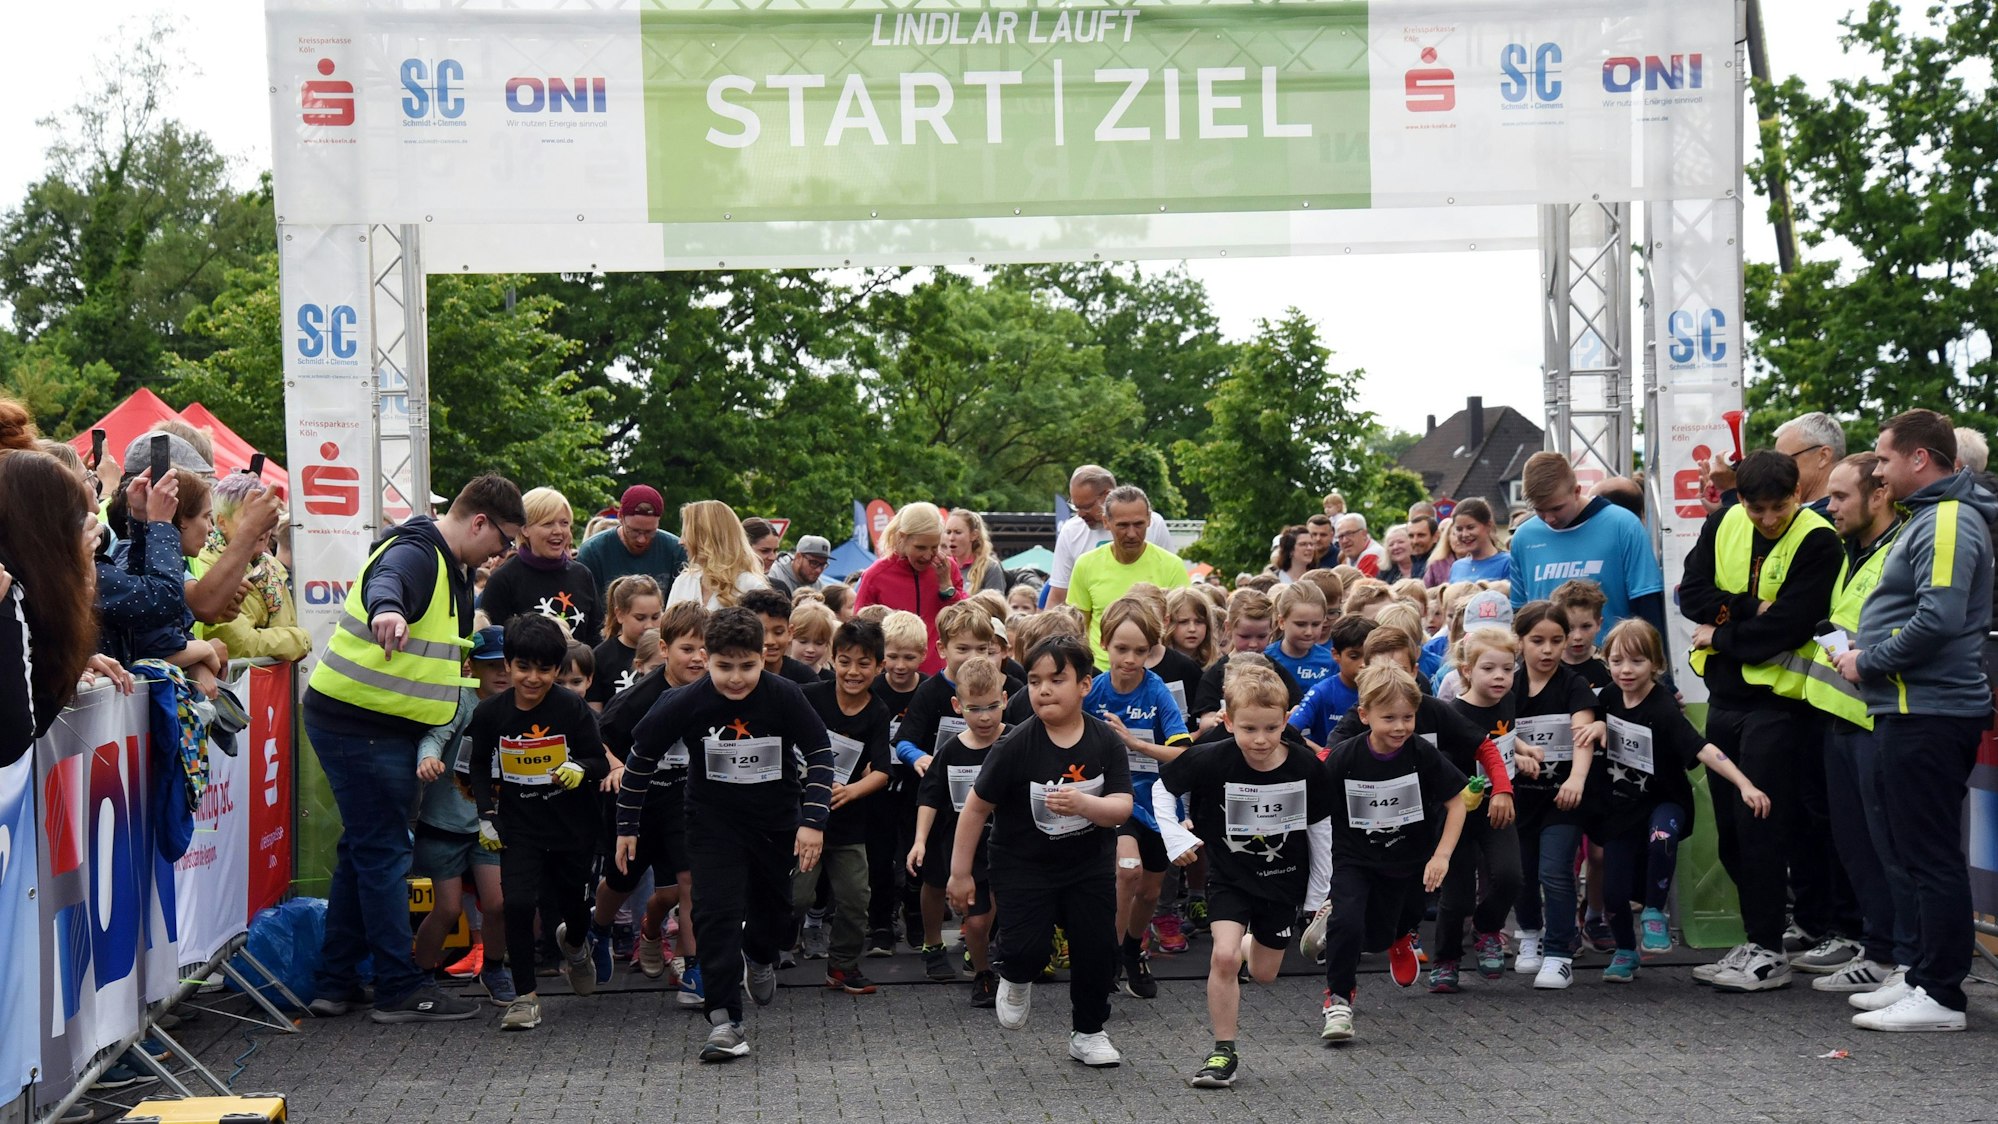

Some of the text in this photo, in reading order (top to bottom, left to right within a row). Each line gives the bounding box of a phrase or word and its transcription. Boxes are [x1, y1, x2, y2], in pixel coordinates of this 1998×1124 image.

[872, 2, 1141, 46] LINDLAR LÄUFT
[1403, 26, 1456, 34] Kreissparkasse
[298, 37, 352, 46] Kreissparkasse
[298, 46, 316, 54] Köln
[1602, 53, 1702, 93] ONI
[505, 77, 607, 113] ONI
[705, 66, 1313, 148] START ZIEL
[402, 119, 431, 127] Schmidt
[437, 119, 467, 127] Clemens
[506, 119, 608, 129] Wir nutzen Energie sinnvoll
[299, 419, 360, 428] Kreissparkasse
[299, 429, 318, 437] Köln
[1671, 433, 1690, 441] Köln
[1479, 602, 1497, 618] M
[1528, 733, 1554, 741] 127
[1621, 737, 1639, 749] 129
[515, 755, 551, 765] 1069
[729, 756, 759, 764] 120
[1369, 798, 1399, 807] 442
[1251, 803, 1283, 813] 113
